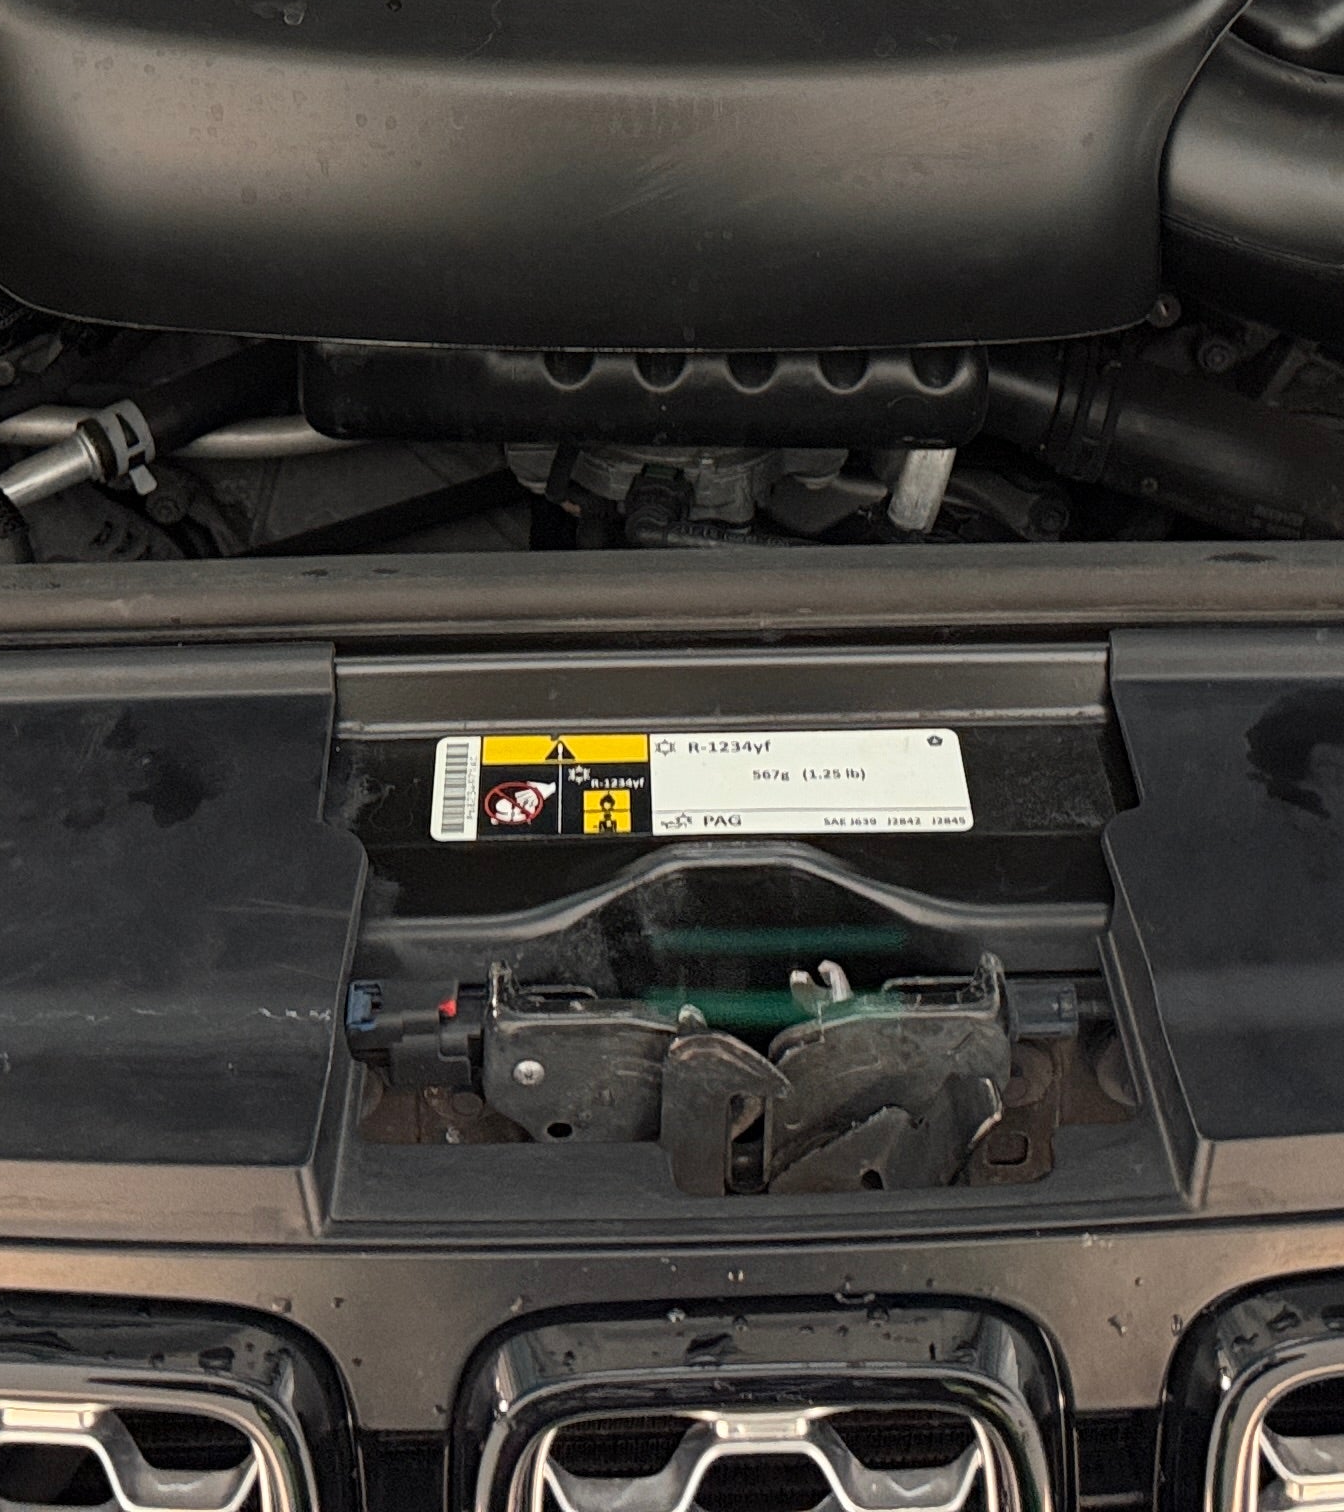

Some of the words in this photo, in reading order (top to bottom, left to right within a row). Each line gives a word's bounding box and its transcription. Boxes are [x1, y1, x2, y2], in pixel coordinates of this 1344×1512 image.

[688, 740, 771, 755] R-1234yf
[752, 769, 790, 782] 567g
[802, 768, 842, 782] (1.25
[845, 767, 866, 781] lb)
[590, 777, 645, 790] R-1234yf
[703, 815, 743, 827] PAG
[823, 817, 846, 827] SAE
